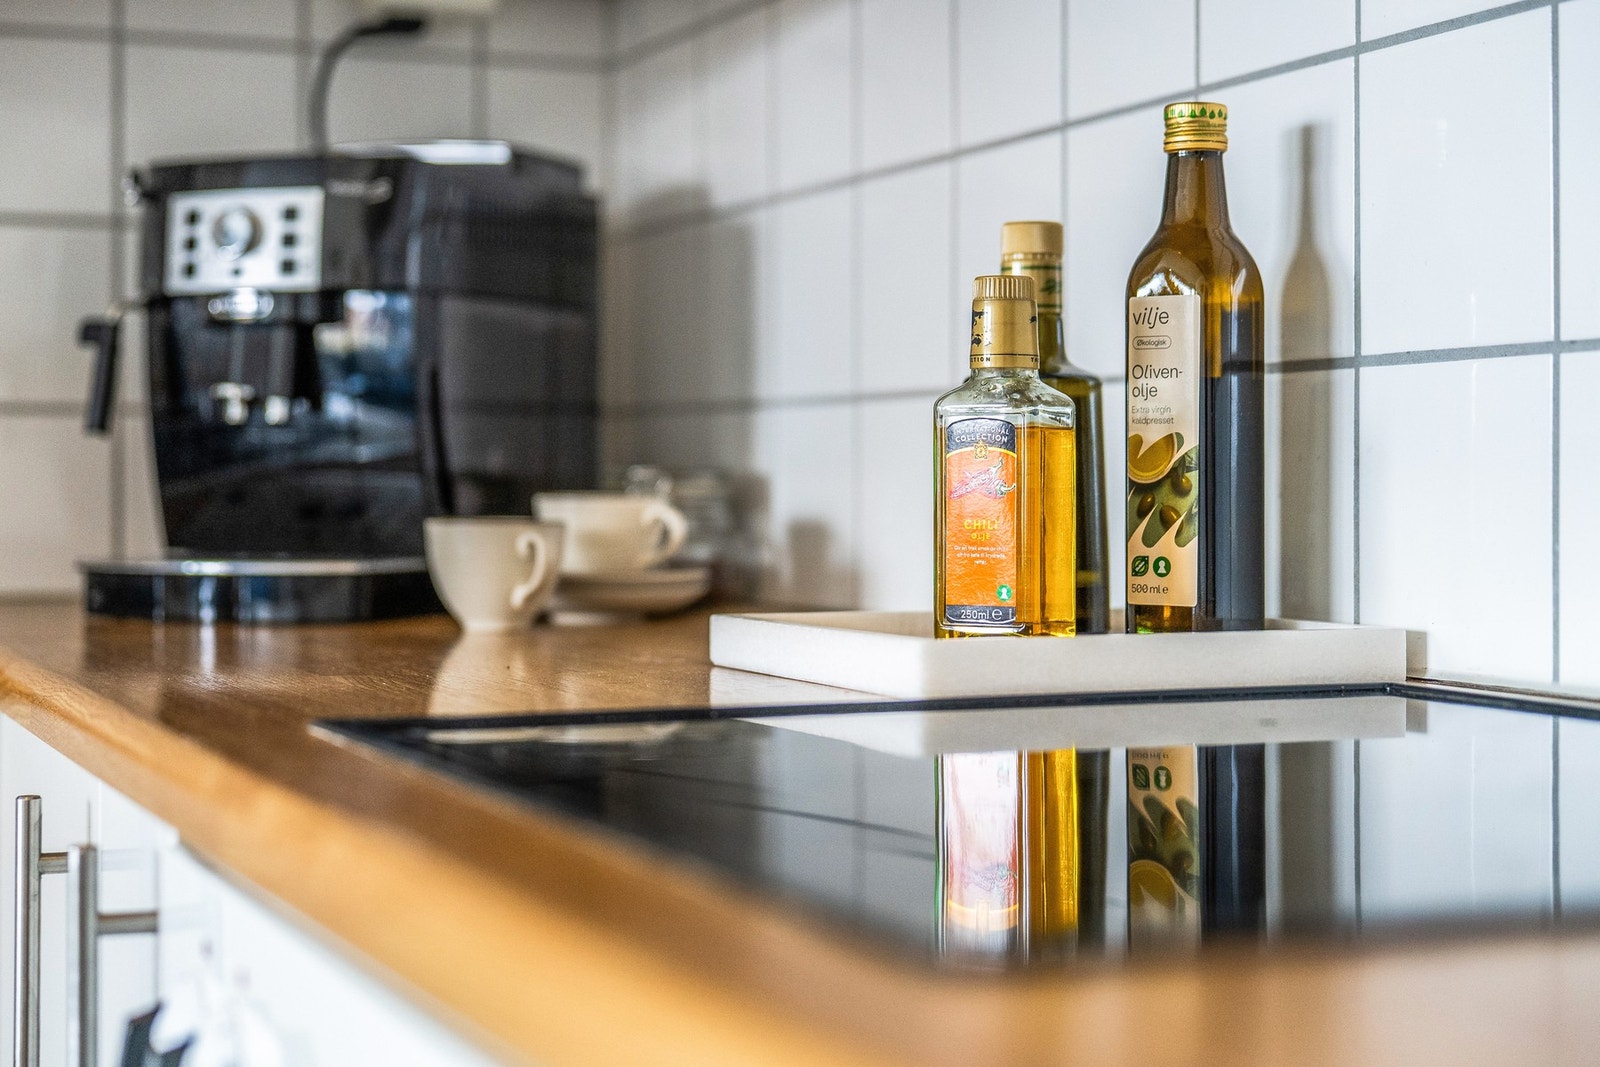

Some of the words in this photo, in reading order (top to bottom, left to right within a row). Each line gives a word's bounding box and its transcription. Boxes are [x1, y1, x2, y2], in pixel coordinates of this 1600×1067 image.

[1132, 306, 1170, 330] vilje
[1131, 364, 1184, 380] Oliven-
[1131, 383, 1159, 401] olje
[1131, 405, 1150, 414] Extra
[1151, 405, 1172, 416] virgin
[1131, 416, 1175, 426] kaldpresset
[955, 433, 1008, 443] COLLECTION
[963, 519, 999, 530] CHILI
[960, 609, 990, 620] 250ml
